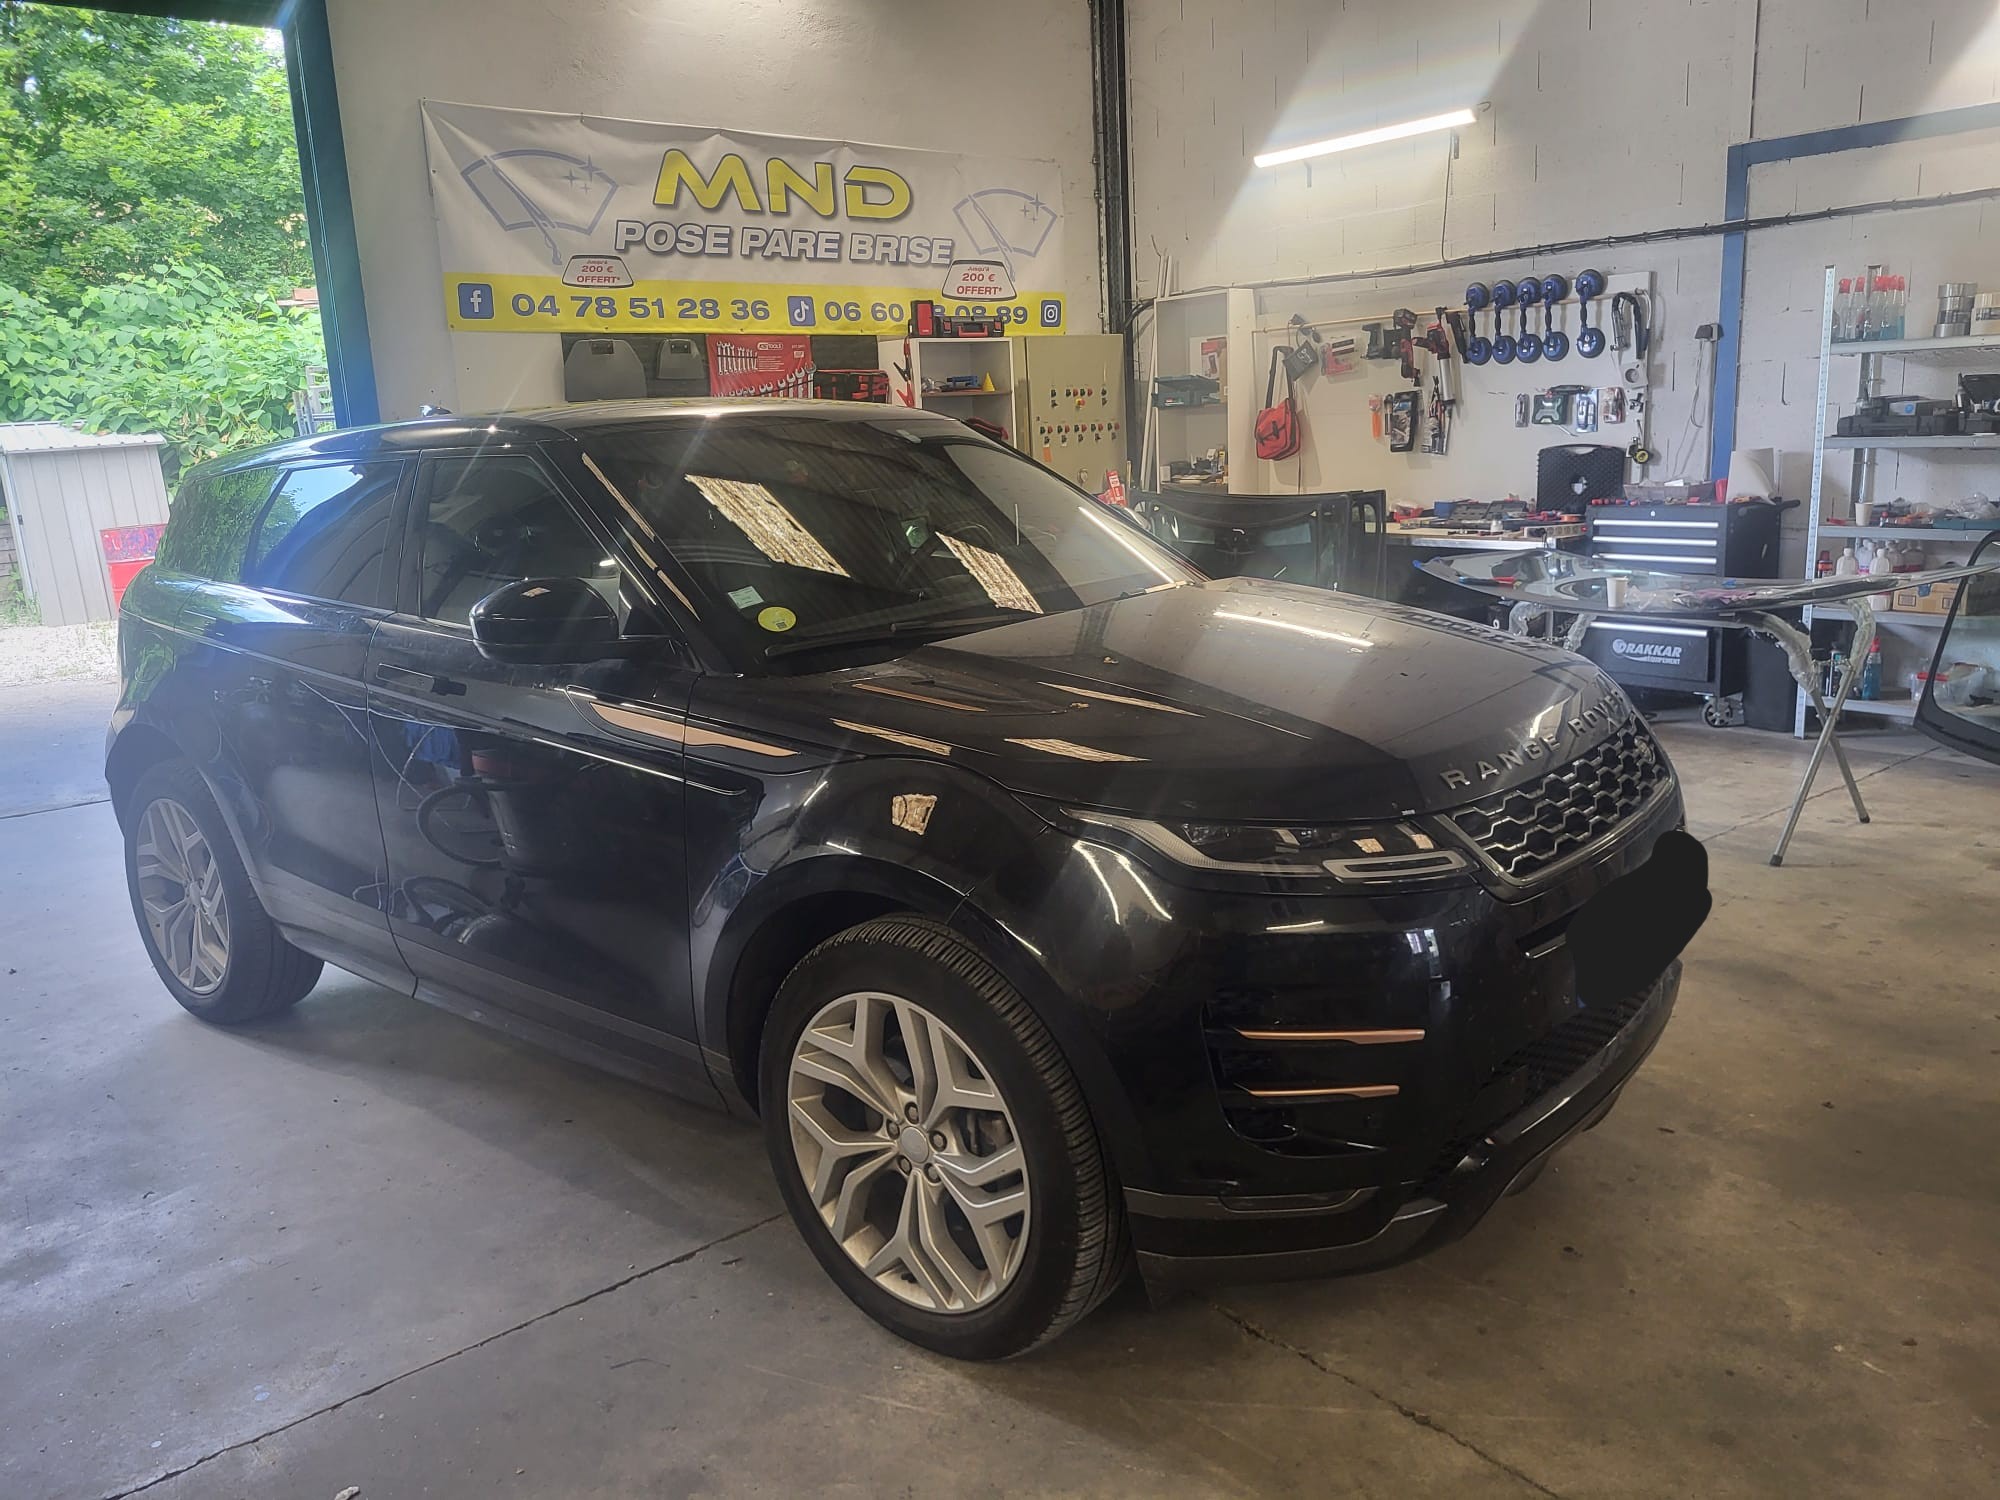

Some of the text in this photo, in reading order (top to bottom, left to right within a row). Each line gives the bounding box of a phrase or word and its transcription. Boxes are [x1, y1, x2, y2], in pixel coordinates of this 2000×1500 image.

[654, 149, 913, 219] MND
[615, 220, 954, 265] POSE PARE BRISE
[582, 265, 603, 273] 200
[962, 273, 996, 282] 200 €
[511, 294, 770, 320] 04 78 51 28 36
[824, 301, 861, 321] 06
[871, 302, 904, 322] 60
[996, 306, 1028, 325] 89
[1440, 735, 1561, 790] RANGE
